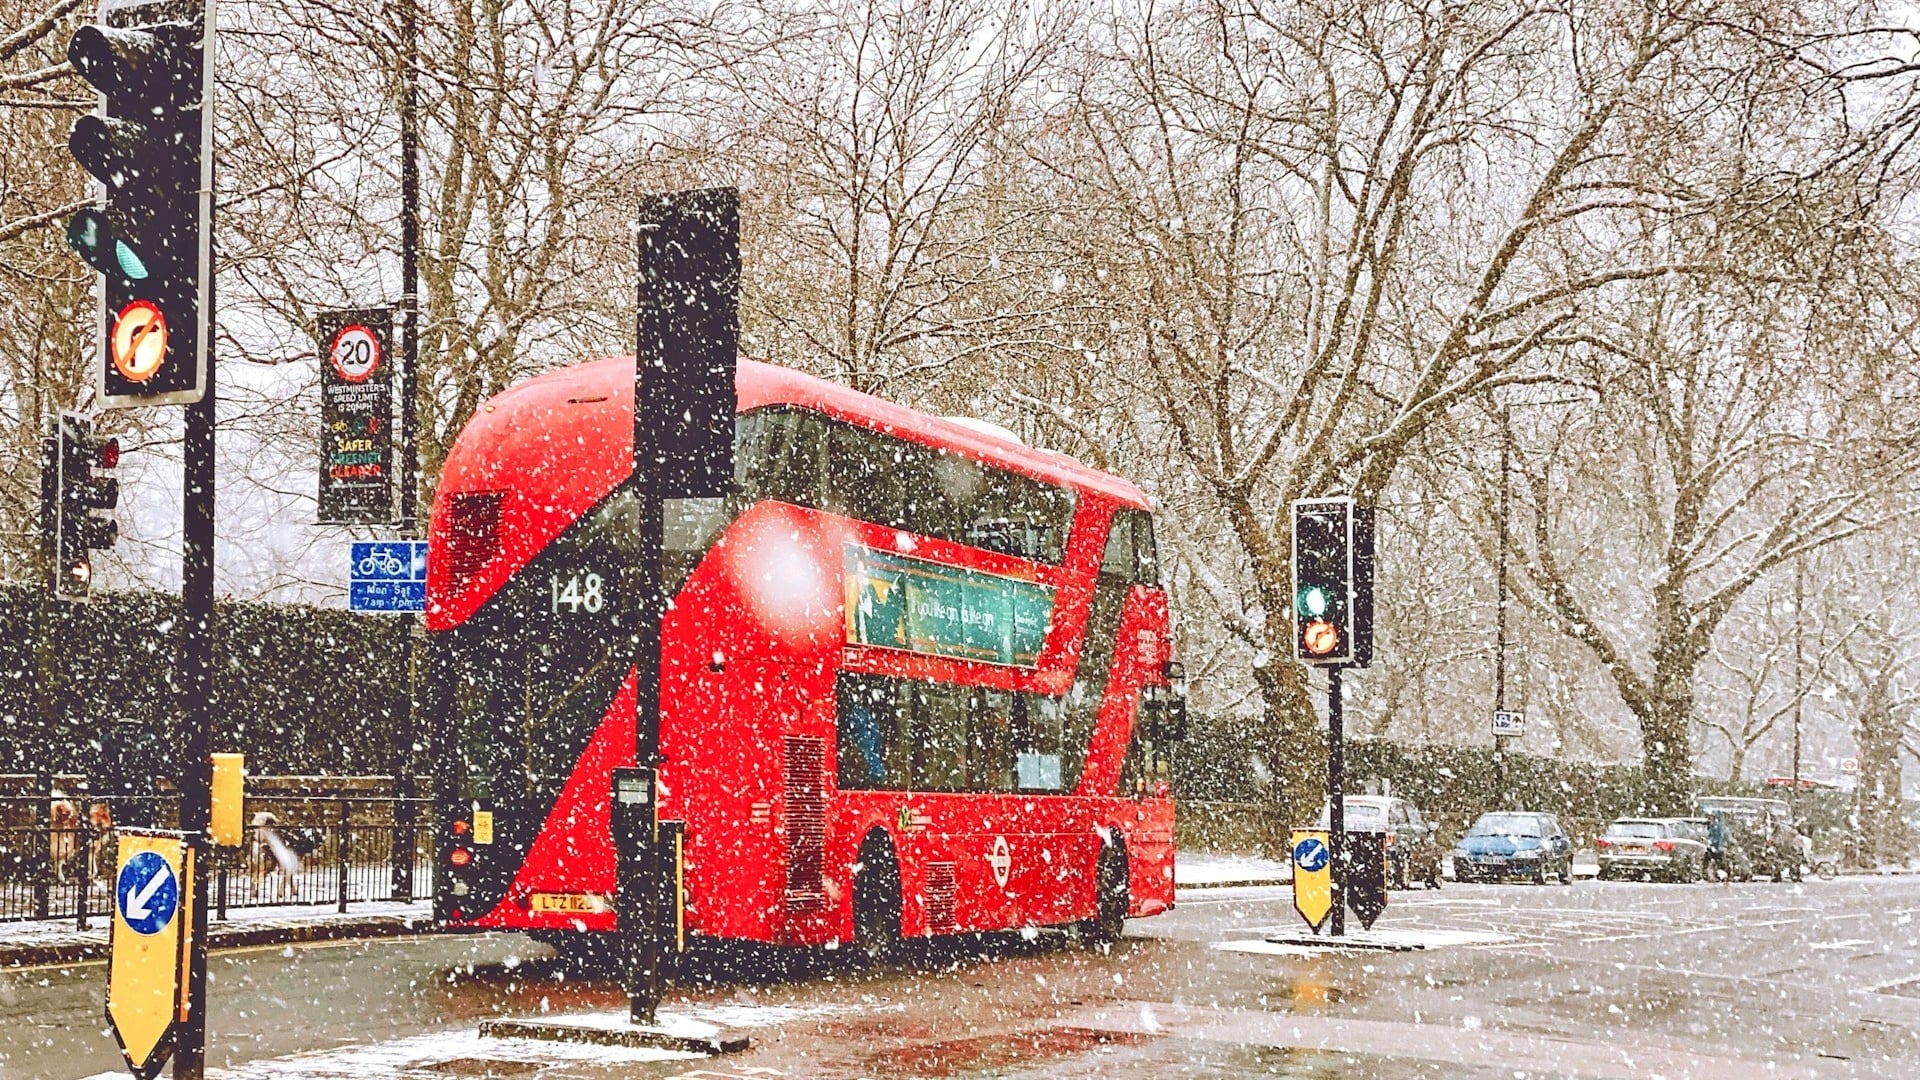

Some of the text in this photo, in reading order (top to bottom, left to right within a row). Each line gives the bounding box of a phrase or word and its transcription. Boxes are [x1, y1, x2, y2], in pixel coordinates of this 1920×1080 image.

[341, 340, 370, 365] 20
[337, 439, 372, 452] SAFER
[551, 573, 602, 614] 148
[542, 896, 567, 909] LTZ
